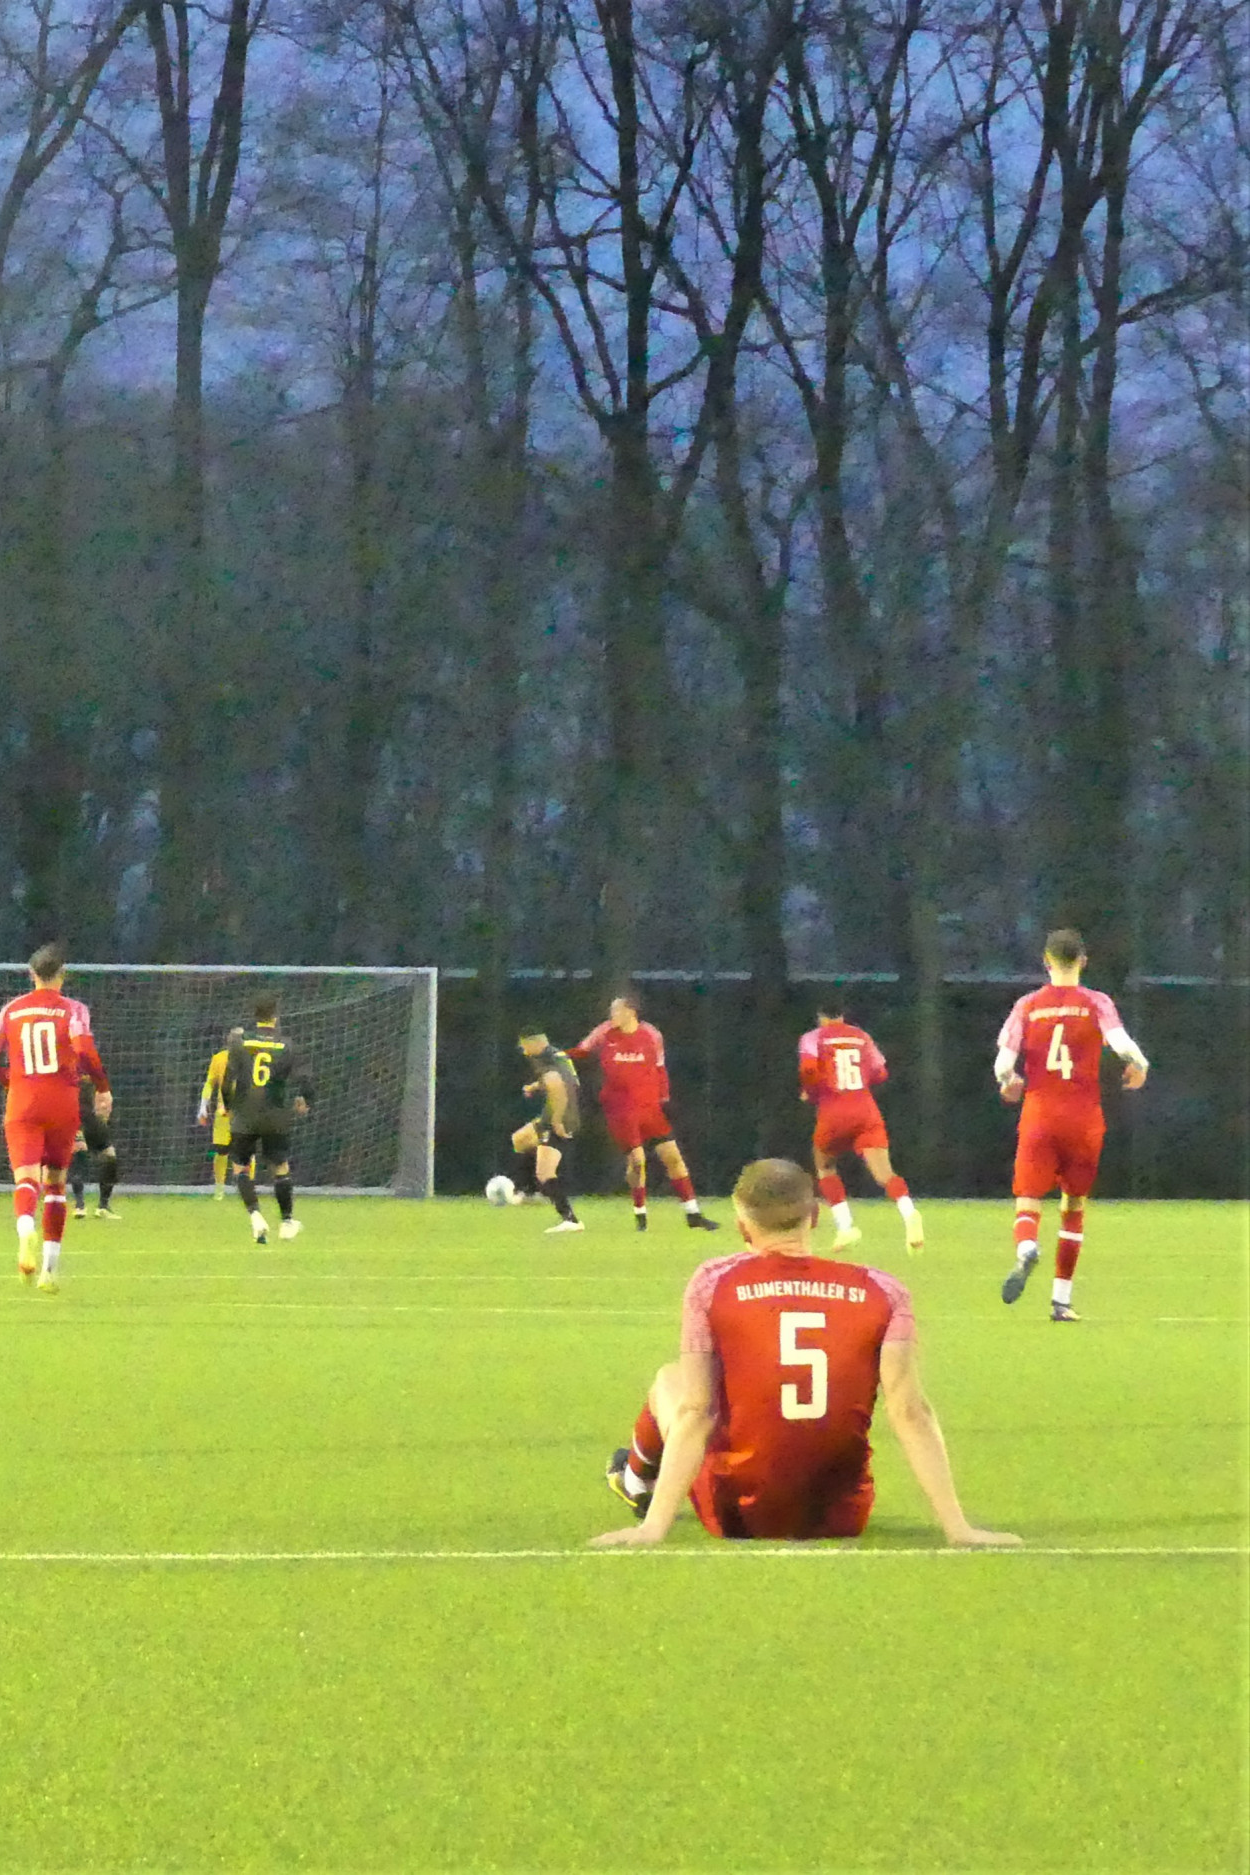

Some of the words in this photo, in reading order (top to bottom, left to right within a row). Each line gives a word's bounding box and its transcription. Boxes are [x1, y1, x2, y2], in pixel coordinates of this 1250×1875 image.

[21, 1021, 59, 1075] 10
[253, 1052, 272, 1087] 6
[1046, 1023, 1073, 1080] 4
[736, 1280, 844, 1302] BLUMENTHALER
[848, 1286, 866, 1303] SV
[780, 1311, 828, 1420] 5
